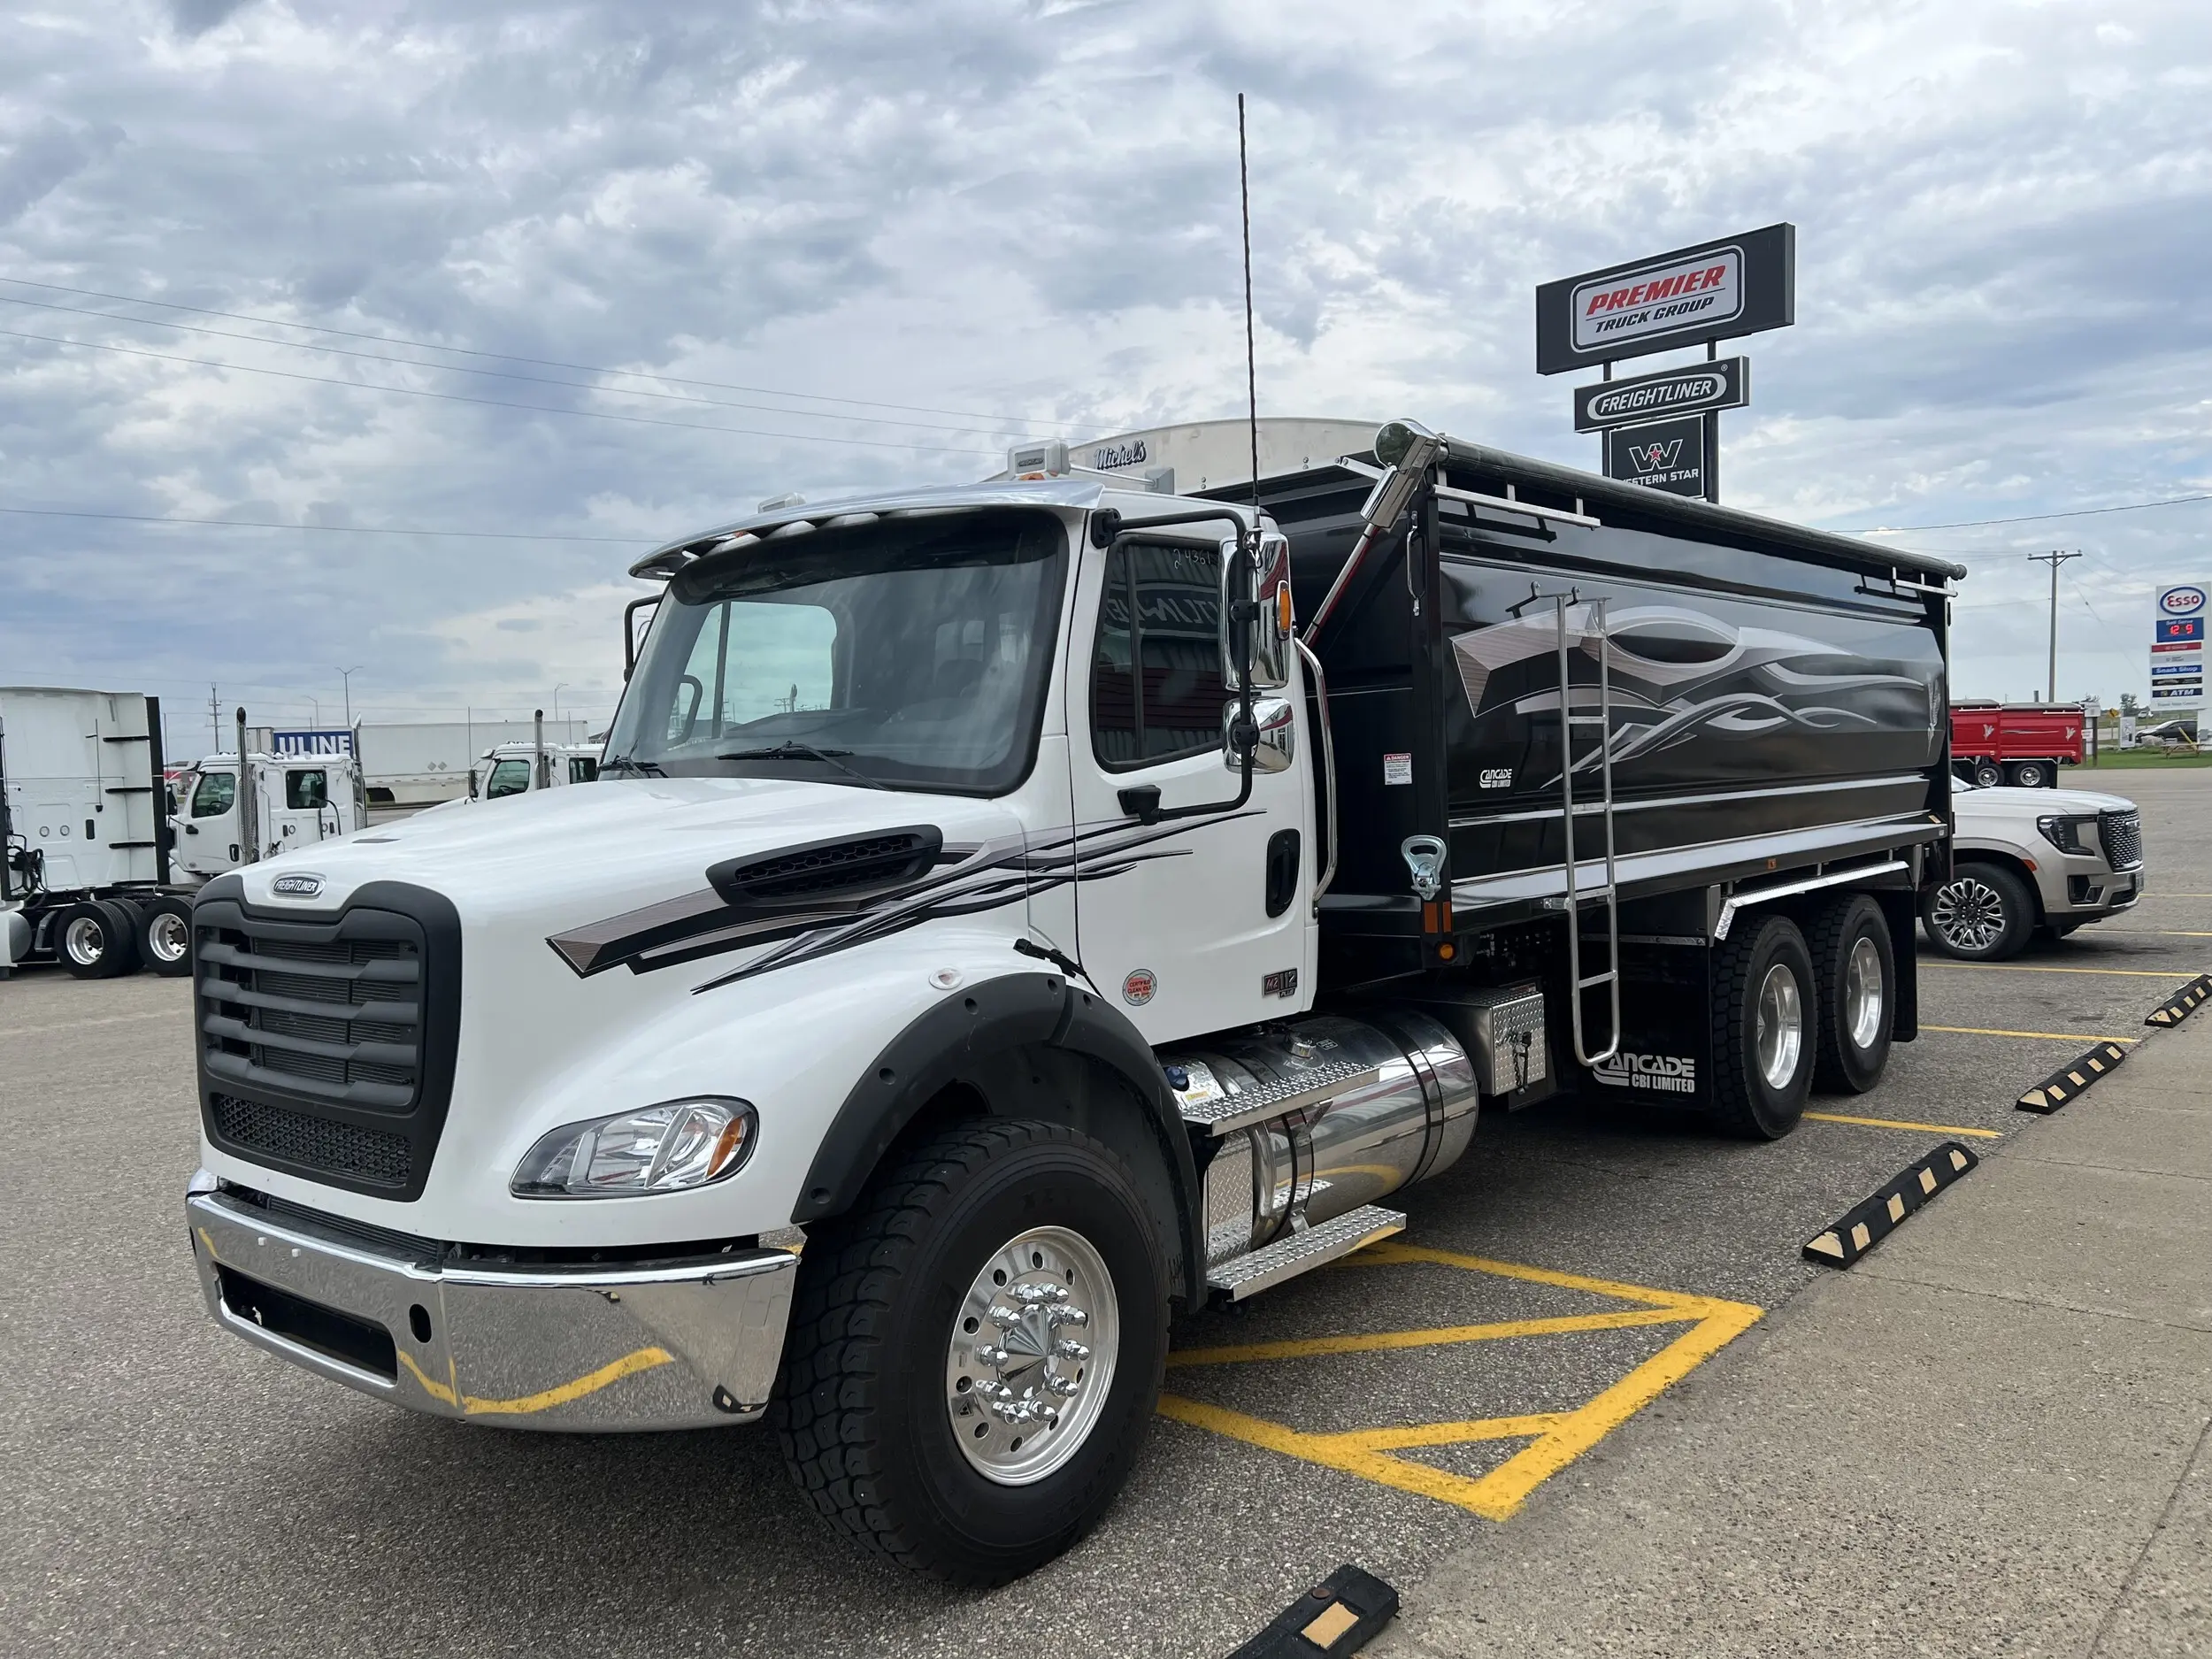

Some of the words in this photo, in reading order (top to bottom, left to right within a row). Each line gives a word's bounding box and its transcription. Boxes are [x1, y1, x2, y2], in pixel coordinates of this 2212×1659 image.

[1586, 265, 1726, 316] PREMIER
[1595, 311, 1652, 334] TRUCK
[1653, 296, 1715, 320] GROUP
[1600, 380, 1712, 413] FREIGHTLINER
[1094, 439, 1147, 470] Michel's
[1622, 472, 1667, 486] ESTERN
[1670, 468, 1699, 481] STAR
[278, 734, 351, 756] ULINE
[274, 879, 318, 892] FREIGHTLINER
[1593, 1050, 1695, 1087] CANCADE
[1632, 1073, 1651, 1088] CBI
[1652, 1075, 1695, 1093] LIMITED
